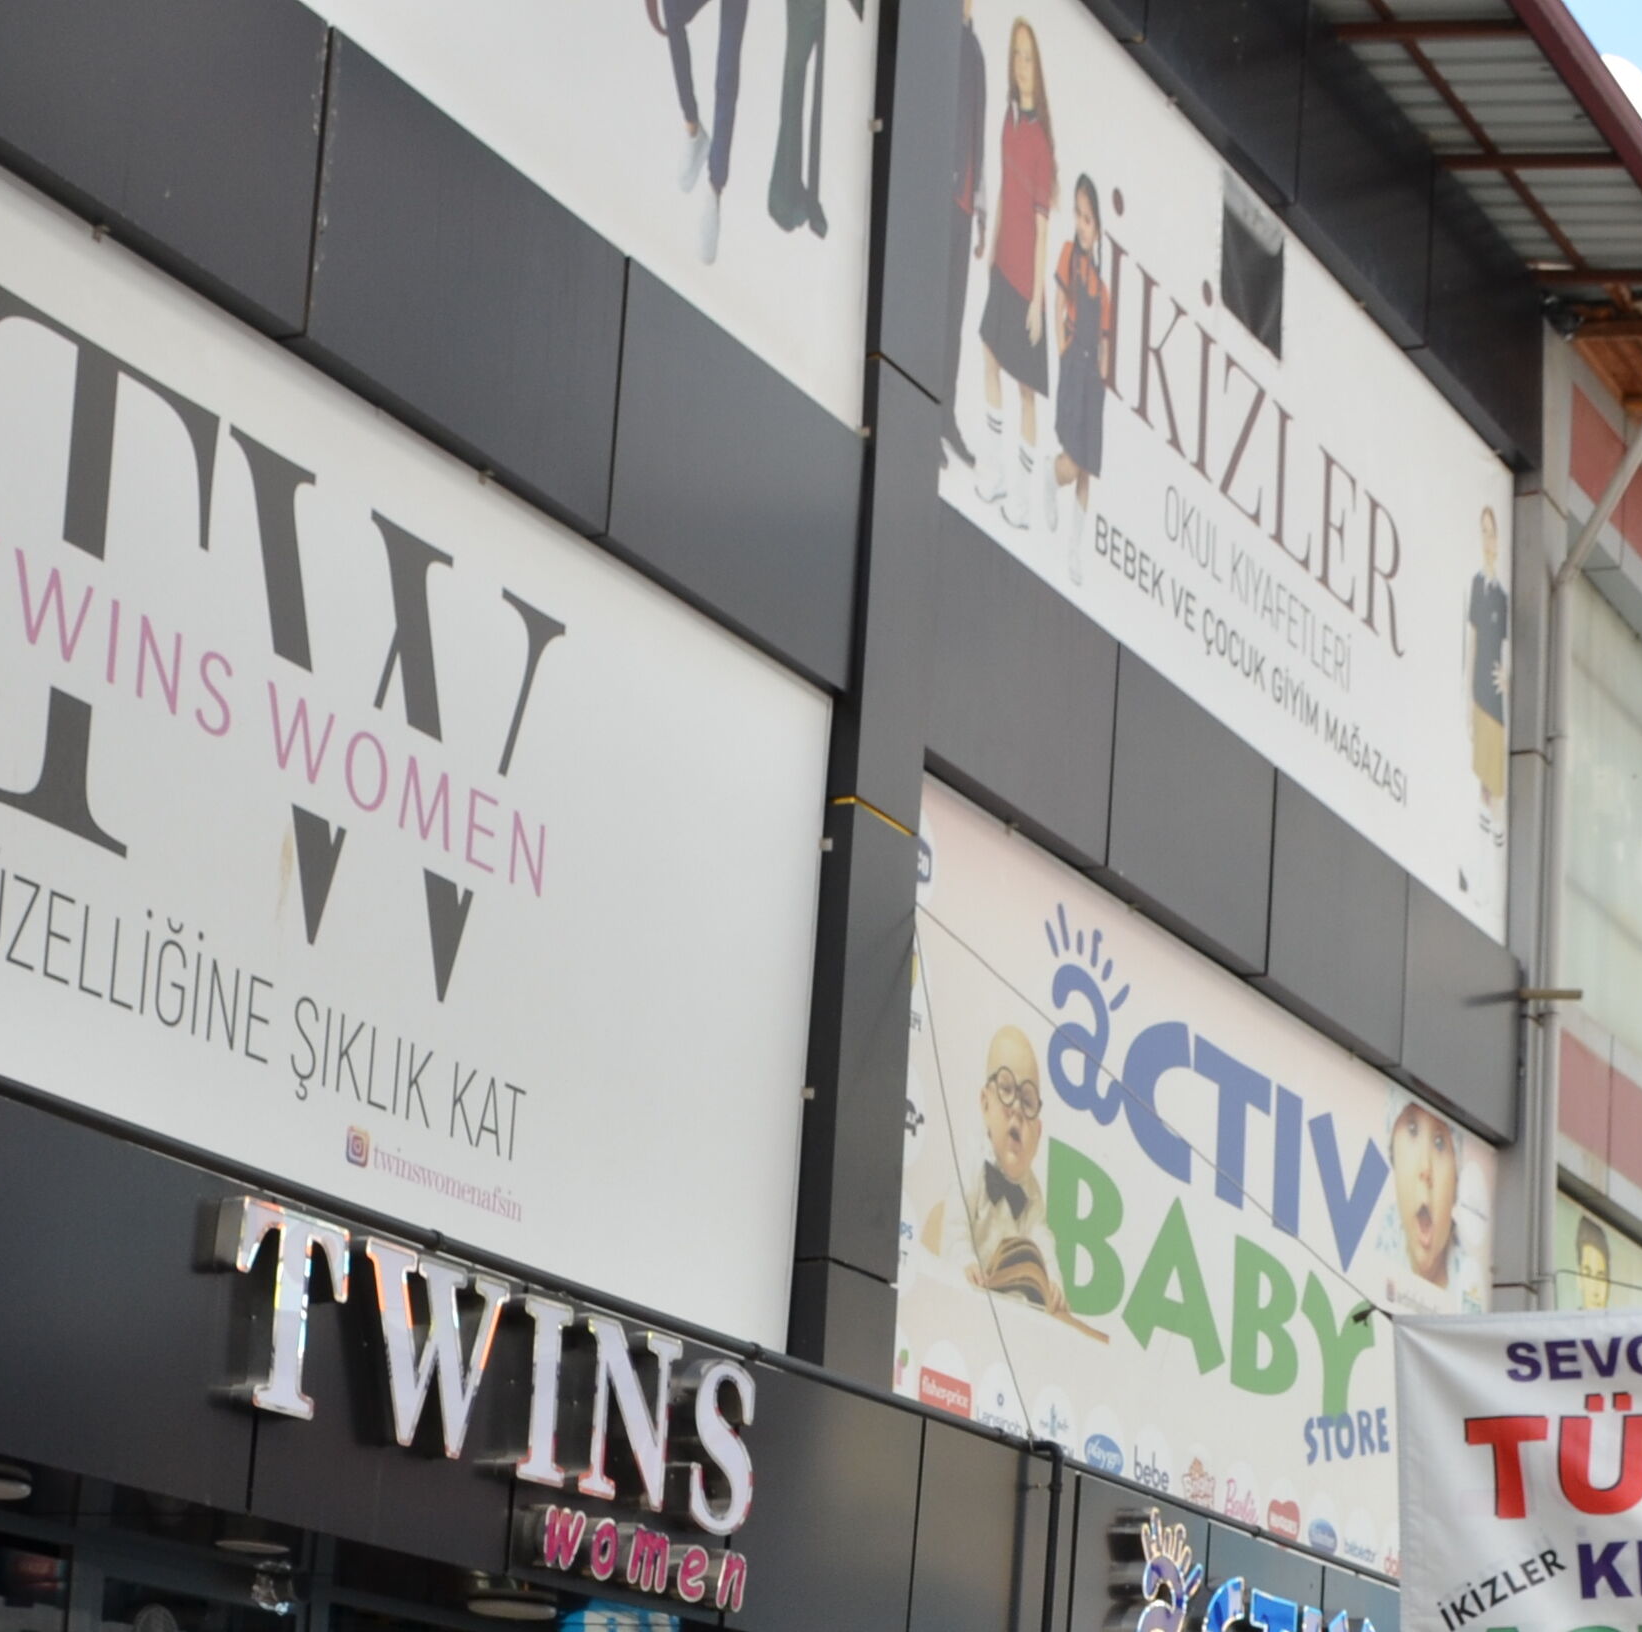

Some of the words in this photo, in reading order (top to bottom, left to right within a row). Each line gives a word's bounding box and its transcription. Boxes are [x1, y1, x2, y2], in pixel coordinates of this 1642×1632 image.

[1095, 512, 1165, 606] BEBEK
[1171, 590, 1196, 632] VE
[1202, 608, 1266, 691] ÇOCUK
[1270, 661, 1320, 733] GİYİM
[1325, 716, 1408, 807] MAĞAZASI
[1165, 485, 1223, 584] OKUL
[1230, 549, 1352, 693] KIYAFETLERİ
[268, 680, 547, 897] WOMEN
[290, 996, 435, 1128] ŞIKLIK
[450, 1059, 528, 1162] KAT
[236, 1195, 756, 1536] TWINS
[1047, 1136, 1376, 1420] BABY
[1303, 1406, 1391, 1466] STORE
[542, 1504, 747, 1612] women
[1437, 1547, 1570, 1632] İKİZLER
